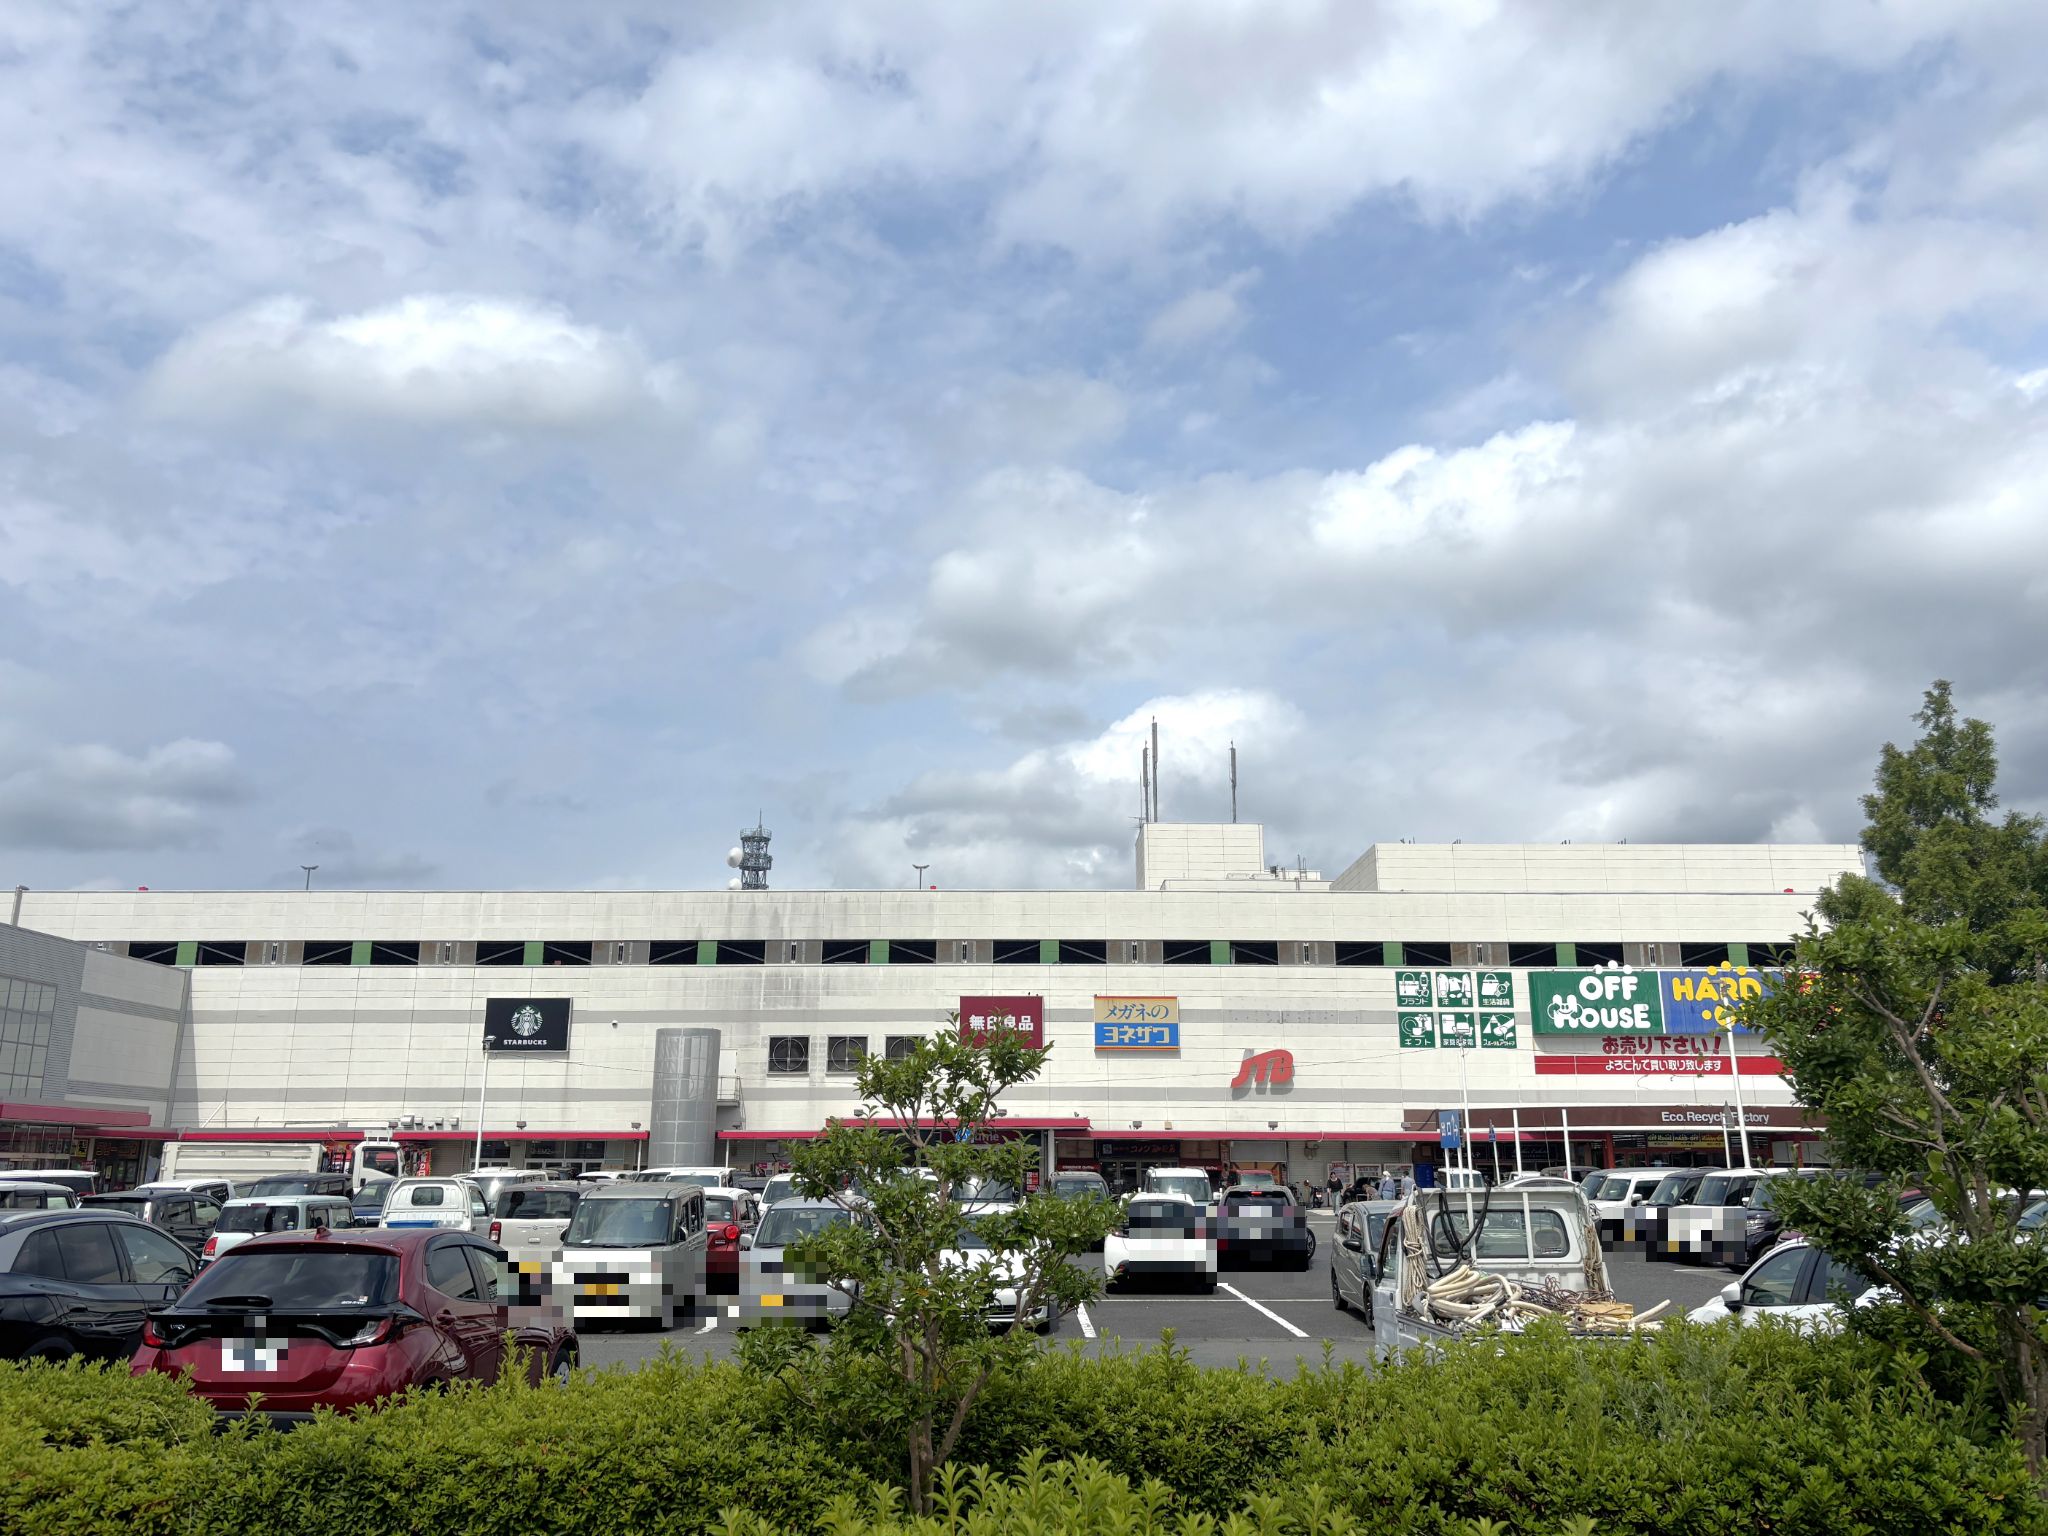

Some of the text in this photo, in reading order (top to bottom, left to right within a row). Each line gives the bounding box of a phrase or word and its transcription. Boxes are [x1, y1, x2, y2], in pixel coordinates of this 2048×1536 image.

[1579, 975, 1639, 1001] OFF
[1672, 977, 1762, 1001] HARD
[1104, 1003, 1170, 1021] メガネの
[969, 1014, 1034, 1032] 無印良品
[1103, 1025, 1170, 1044] ヨネザワ
[1230, 1049, 1294, 1089] JTB
[1731, 1111, 1770, 1125] Fctory
